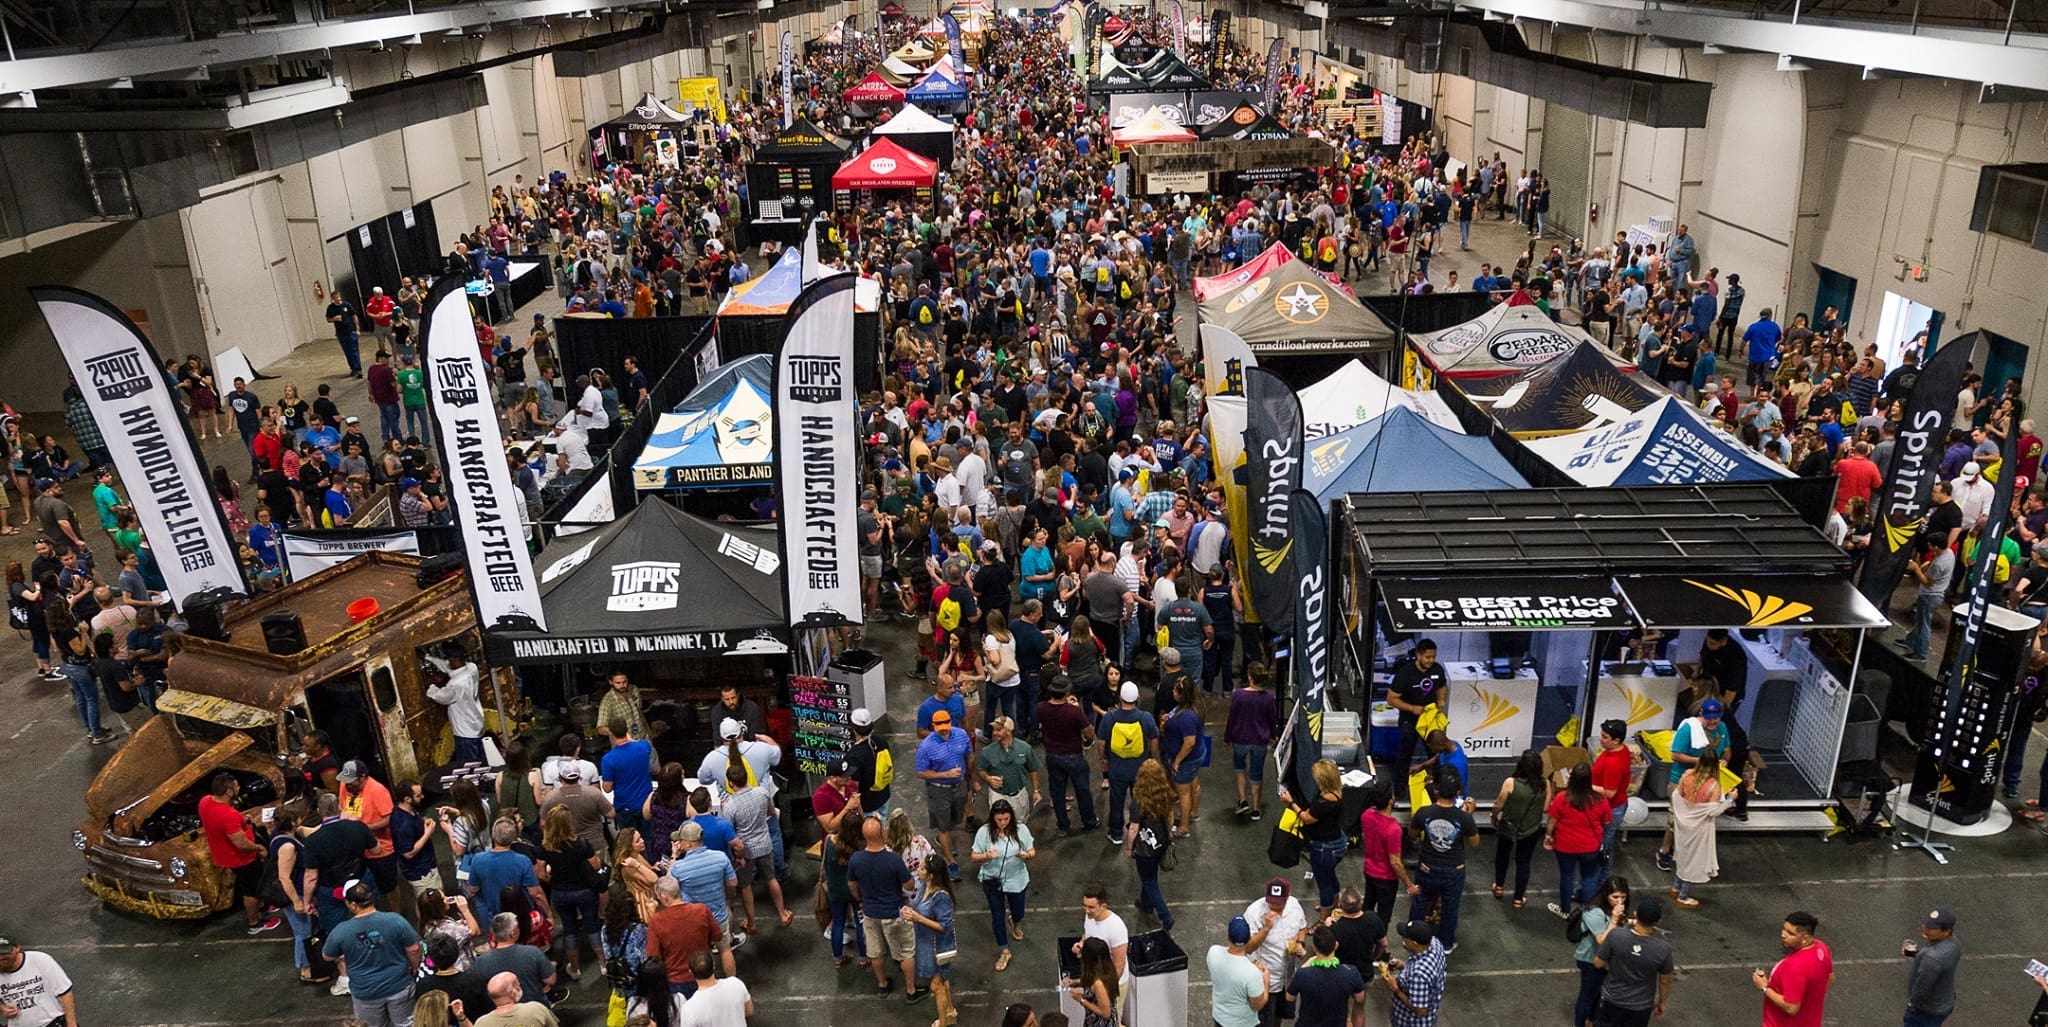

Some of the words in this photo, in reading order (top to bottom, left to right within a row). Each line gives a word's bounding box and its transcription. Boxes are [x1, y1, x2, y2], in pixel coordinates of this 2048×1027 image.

[789, 360, 842, 386] TUPPS
[1663, 422, 1739, 473] ASSEMBLY
[1889, 409, 1942, 517] Sprint
[676, 467, 729, 482] PANTHER
[731, 465, 773, 480] ISLAND
[455, 418, 518, 576] HANDCRAFTED
[801, 415, 838, 573] HANDCRAFTED
[318, 542, 345, 551] TUPPS
[347, 541, 387, 550] BREWERY
[490, 575, 524, 593] BEER
[611, 566, 681, 596] TUPPS
[808, 572, 840, 590] BEER
[1398, 597, 1452, 609] The
[1458, 596, 1532, 609] BEST
[1538, 595, 1618, 608] Price
[1413, 608, 1457, 620] for
[1463, 606, 1613, 620] Unlimited
[1514, 618, 1564, 627] hulu
[512, 636, 614, 658] HANDCRAFTED
[613, 637, 629, 653] IN
[708, 631, 729, 649] TX
[1463, 736, 1511, 751] Sprint
